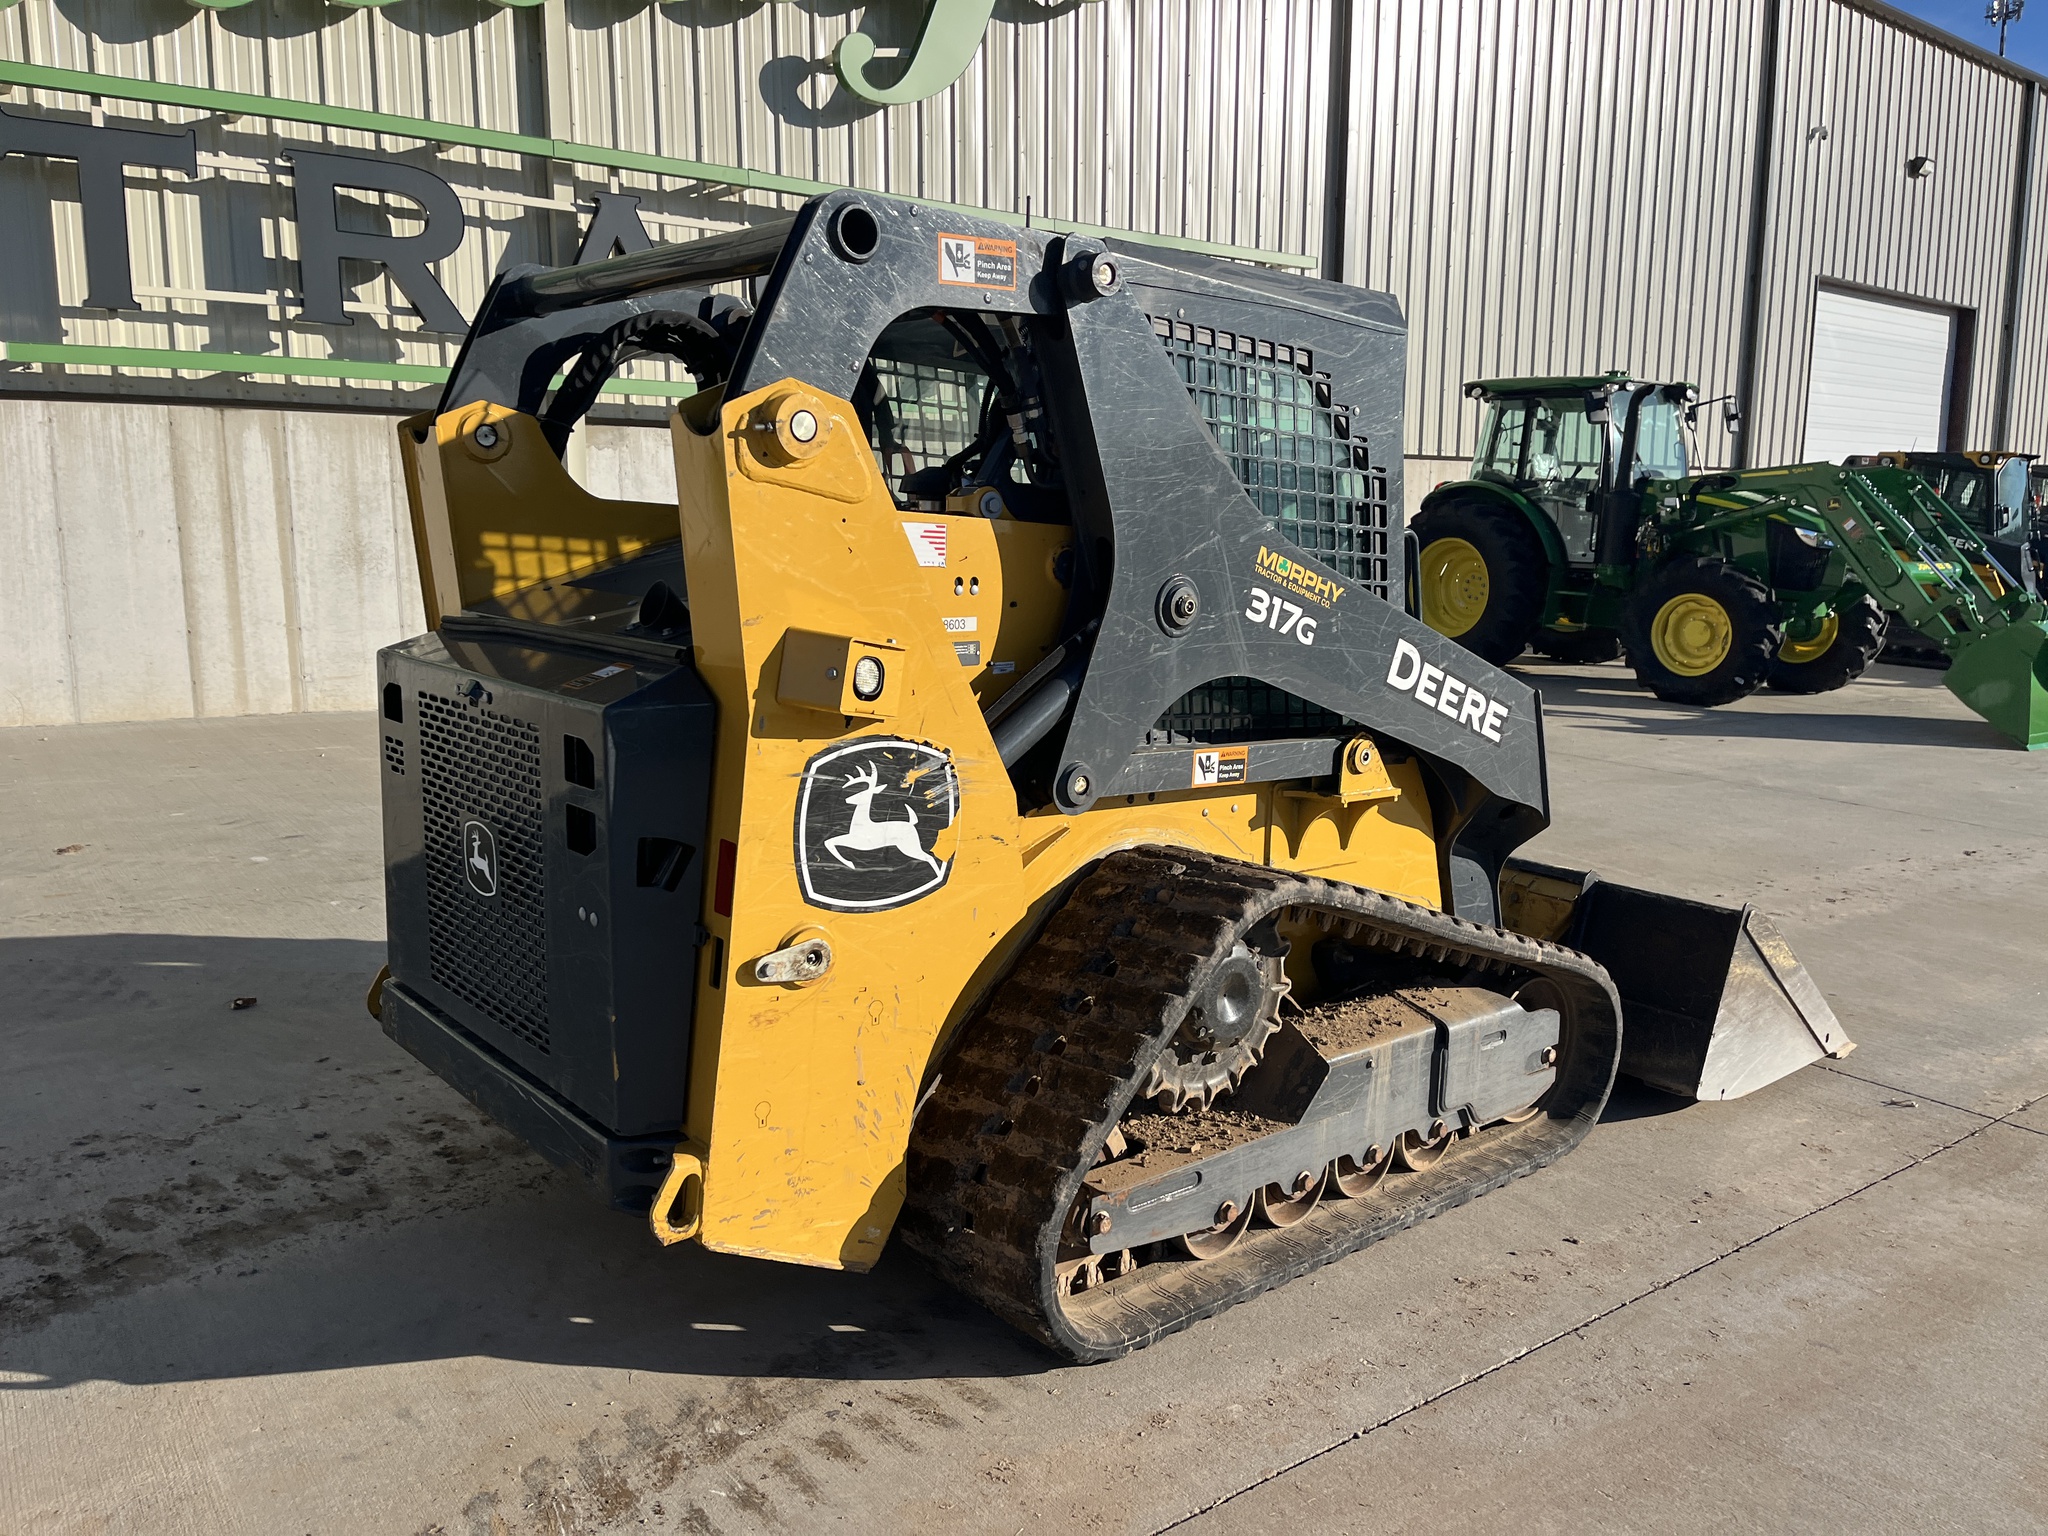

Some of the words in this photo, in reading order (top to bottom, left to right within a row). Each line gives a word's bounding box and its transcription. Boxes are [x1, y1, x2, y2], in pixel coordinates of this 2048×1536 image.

[977, 260, 995, 270] Pinch
[996, 262, 1012, 271] Area
[984, 244, 1013, 254] WARNING
[977, 271, 991, 280] Keep
[992, 272, 1007, 282] Away
[1254, 564, 1283, 585] TRACTOR
[1282, 579, 1288, 588] &
[1287, 581, 1322, 604] EQUIPMENT
[1320, 598, 1331, 609] CO.
[1256, 545, 1345, 603] MURPHY
[1245, 587, 1318, 646] 317G
[1386, 637, 1509, 743] DEERE
